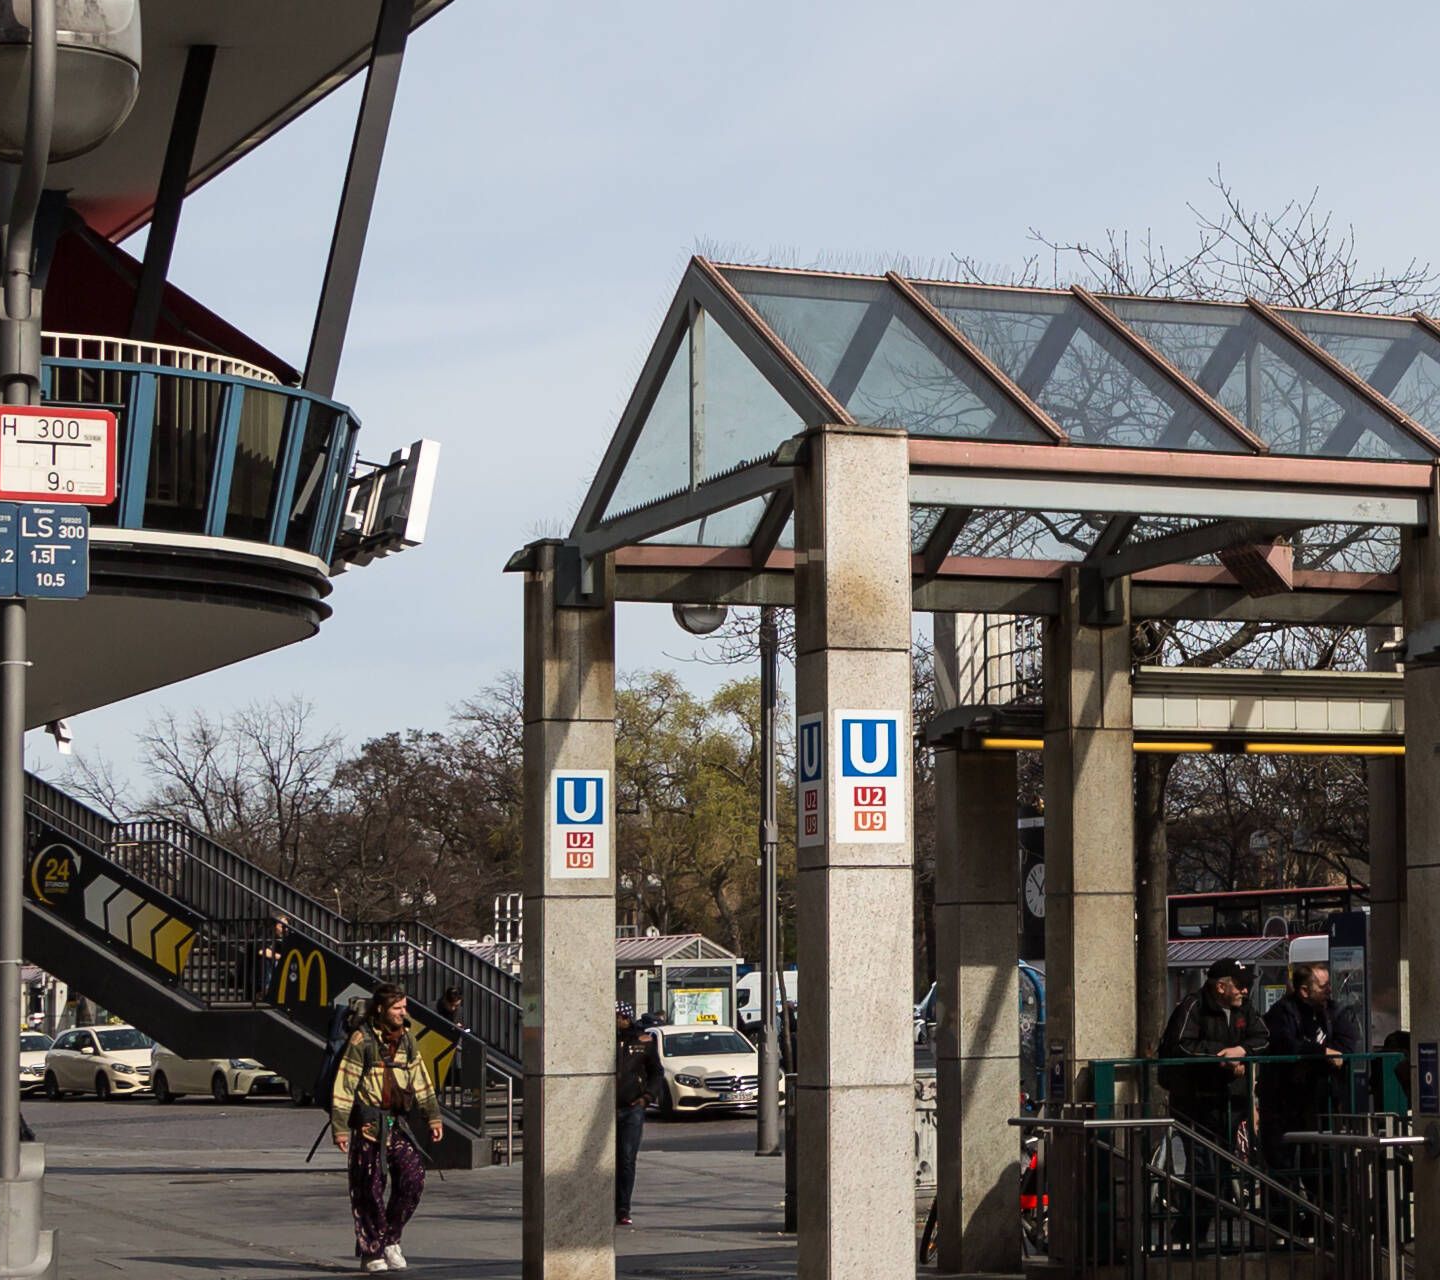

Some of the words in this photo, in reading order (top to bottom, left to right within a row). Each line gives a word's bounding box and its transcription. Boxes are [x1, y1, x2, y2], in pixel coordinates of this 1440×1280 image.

[3, 417, 17, 436] H
[38, 419, 80, 439] 300
[22, 517, 53, 538] LS
[58, 526, 85, 539] 300
[31, 550, 50, 563] 1.5
[36, 573, 65, 587] 10.5
[803, 726, 818, 778] U
[850, 723, 888, 774] U
[564, 781, 596, 822] U
[806, 792, 816, 809] U2
[858, 788, 883, 804] U2
[807, 817, 816, 833] U9
[858, 813, 883, 829] U9
[569, 833, 591, 847] U2
[569, 854, 591, 867] U9
[45, 858, 70, 880] 24
